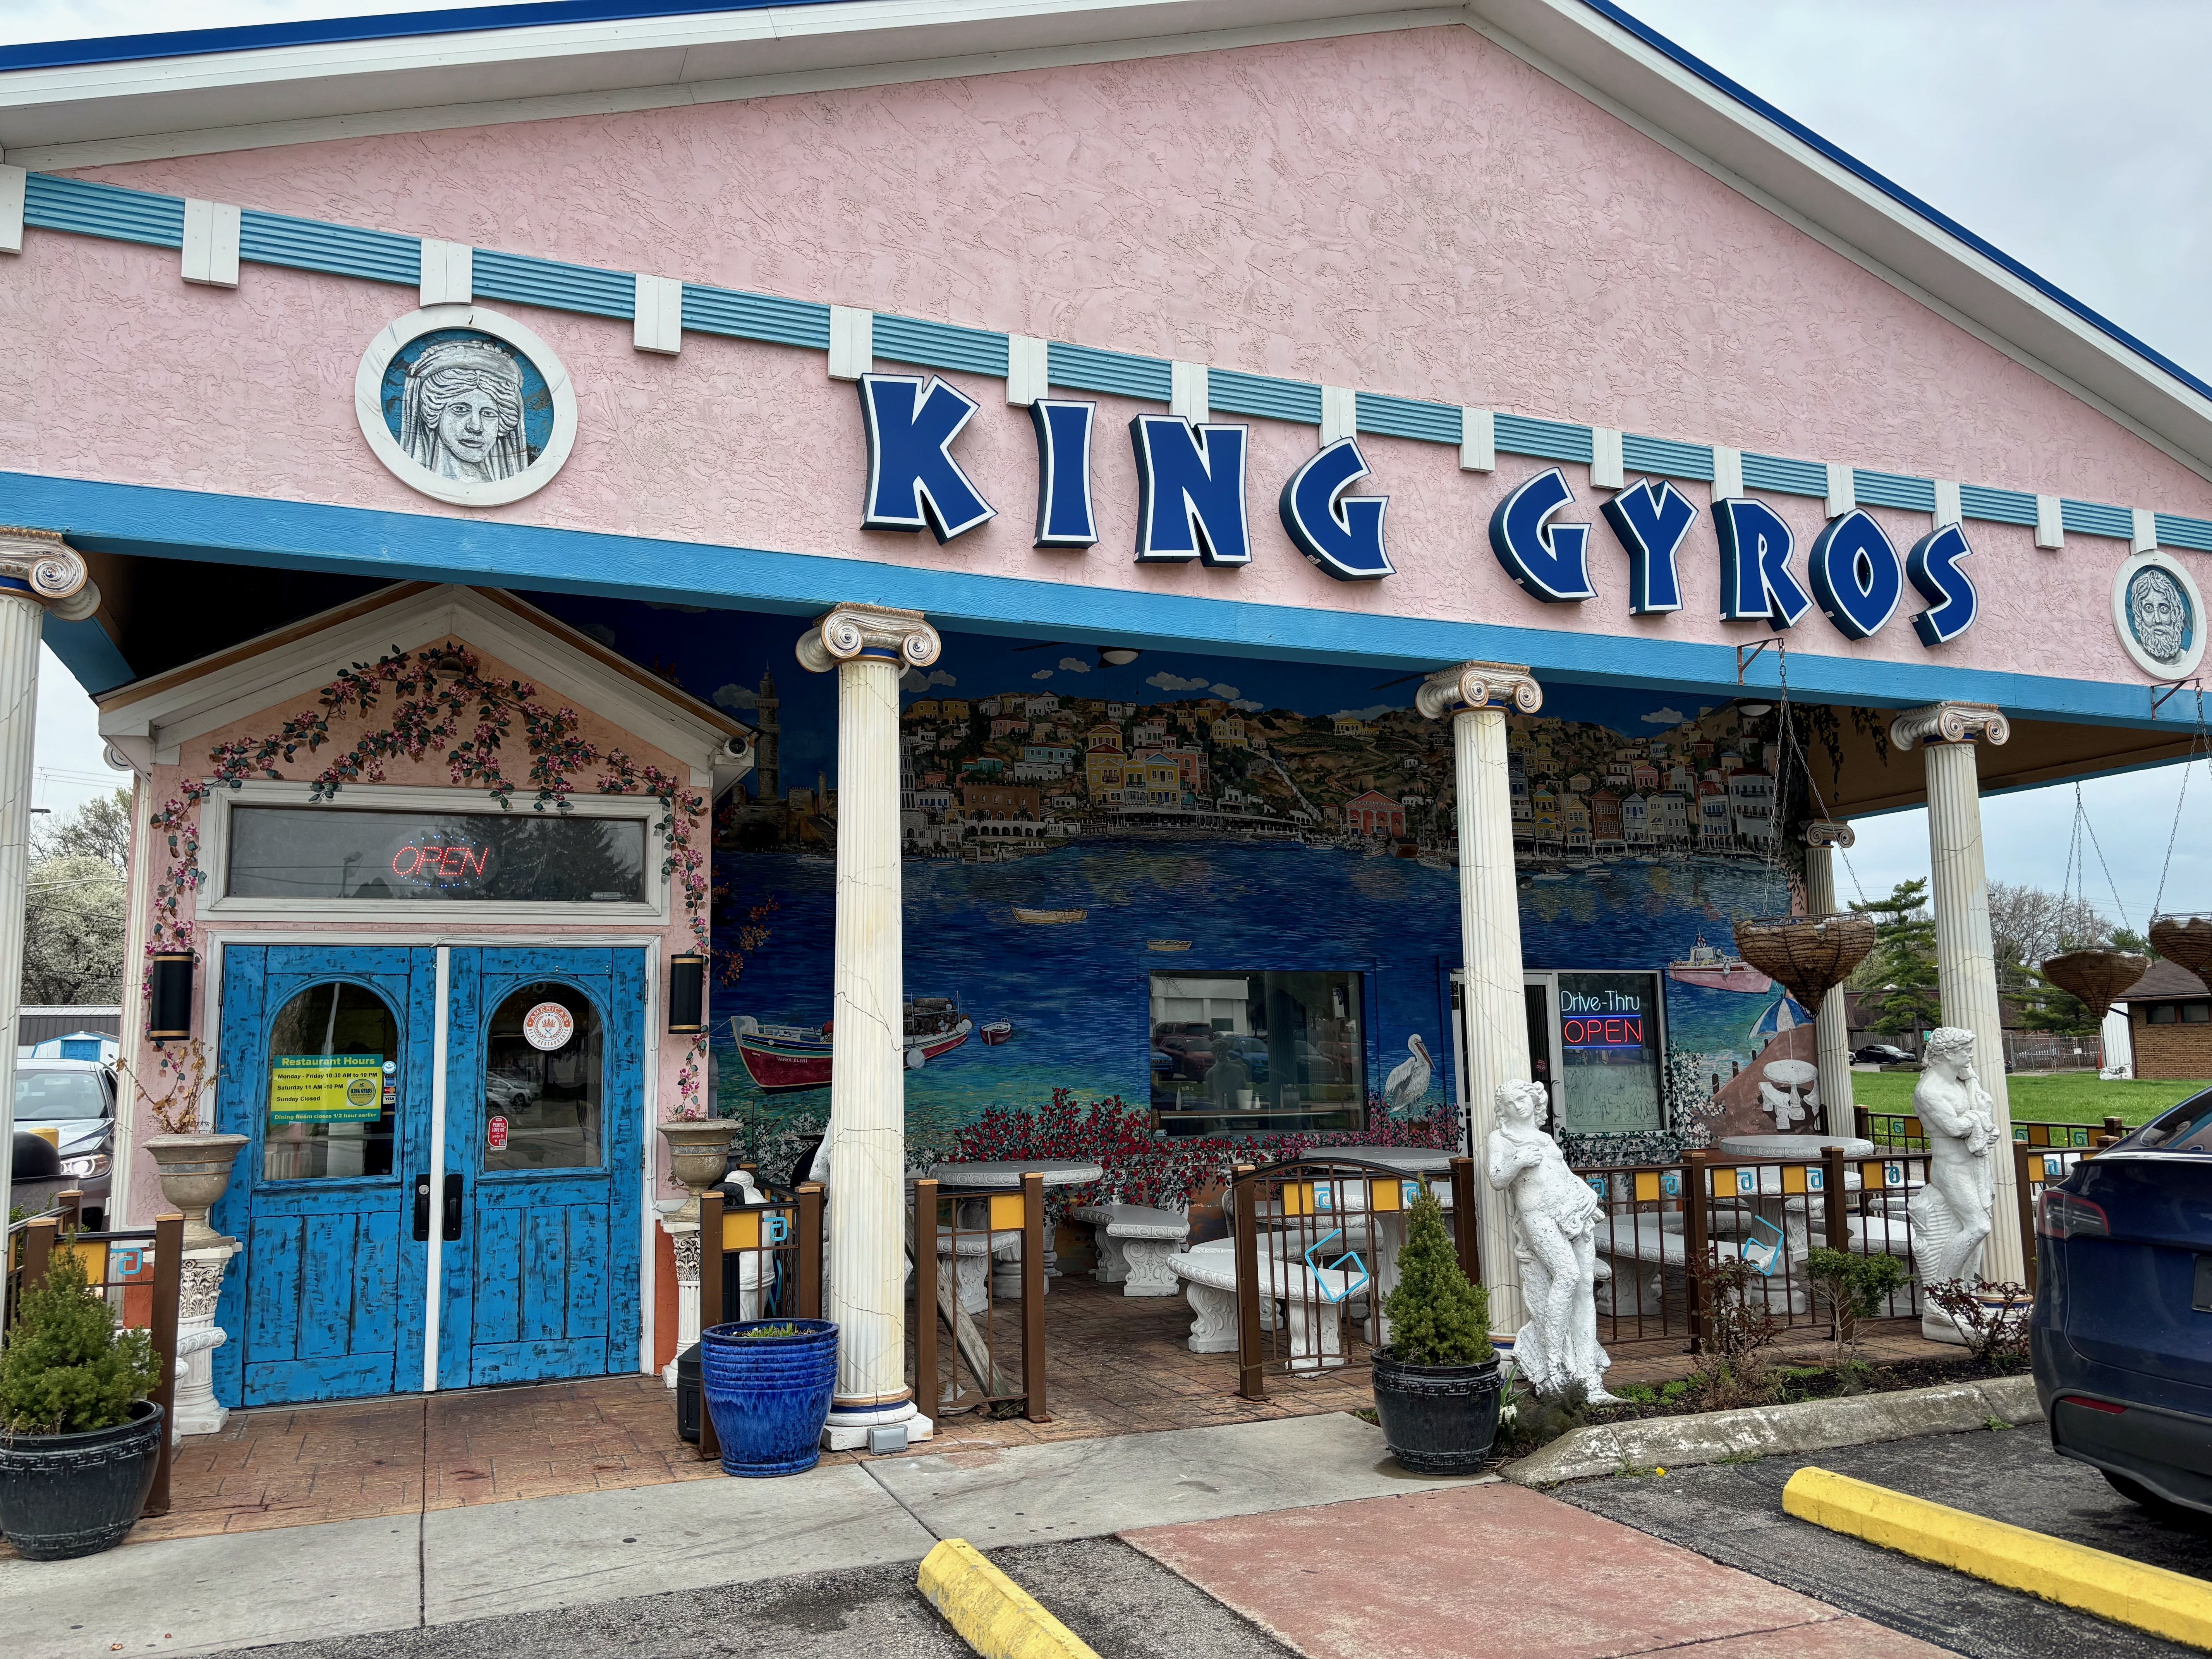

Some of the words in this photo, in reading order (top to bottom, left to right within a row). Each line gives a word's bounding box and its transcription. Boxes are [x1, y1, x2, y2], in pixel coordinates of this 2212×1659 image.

[857, 373, 1397, 583] KING
[1489, 467, 1979, 648] GYROS
[392, 846, 489, 876] OPEN
[1561, 990, 1640, 1012] Drive-Thru
[531, 1006, 568, 1021] AMERICA'S
[1564, 1019, 1642, 1042] OPEN
[282, 1058, 341, 1066] Restaurant
